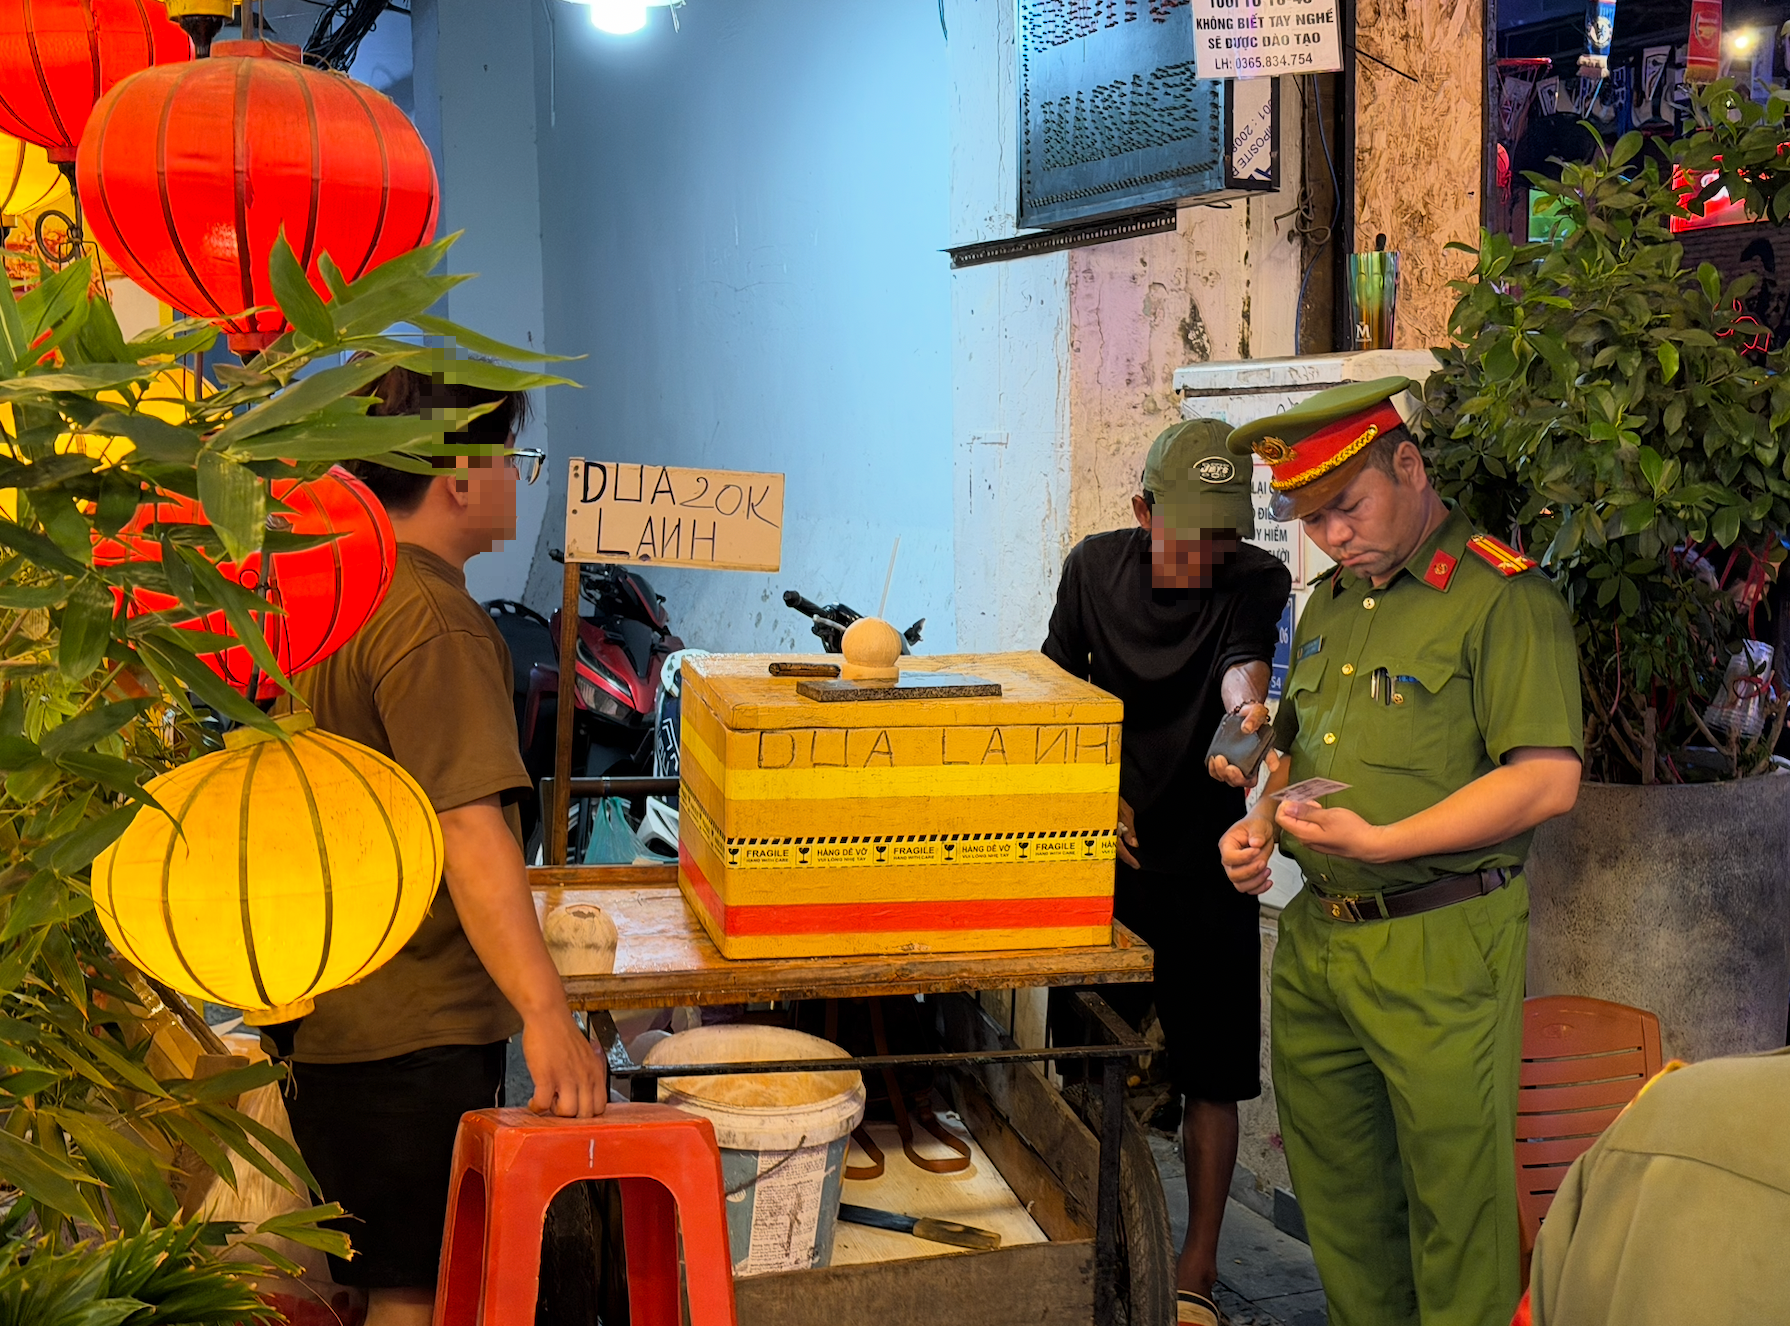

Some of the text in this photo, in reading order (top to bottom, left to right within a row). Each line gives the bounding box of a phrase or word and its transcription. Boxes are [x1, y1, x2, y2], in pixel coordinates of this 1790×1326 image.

[1196, 16, 1233, 30] KHÔNG
[1237, 13, 1264, 29] BIẾT
[1269, 15, 1291, 28] TAY
[1208, 35, 1222, 49] SẼ
[1225, 35, 1258, 51] ĐƯỢC
[1294, 32, 1321, 47] TẠO
[1215, 52, 1313, 70] LH: 0365.834.754
[580, 461, 780, 529] DUA 20K
[1264, 523, 1288, 542] HIỂM
[758, 729, 894, 769] DUA
[746, 849, 789, 858] FRAGILE
[817, 848, 841, 856] HÀNG
[894, 846, 935, 855] FRAGILE
[962, 843, 985, 853] HÀNG
[1036, 842, 1076, 851] FRAGILE
[1102, 841, 1117, 849] HÀN
